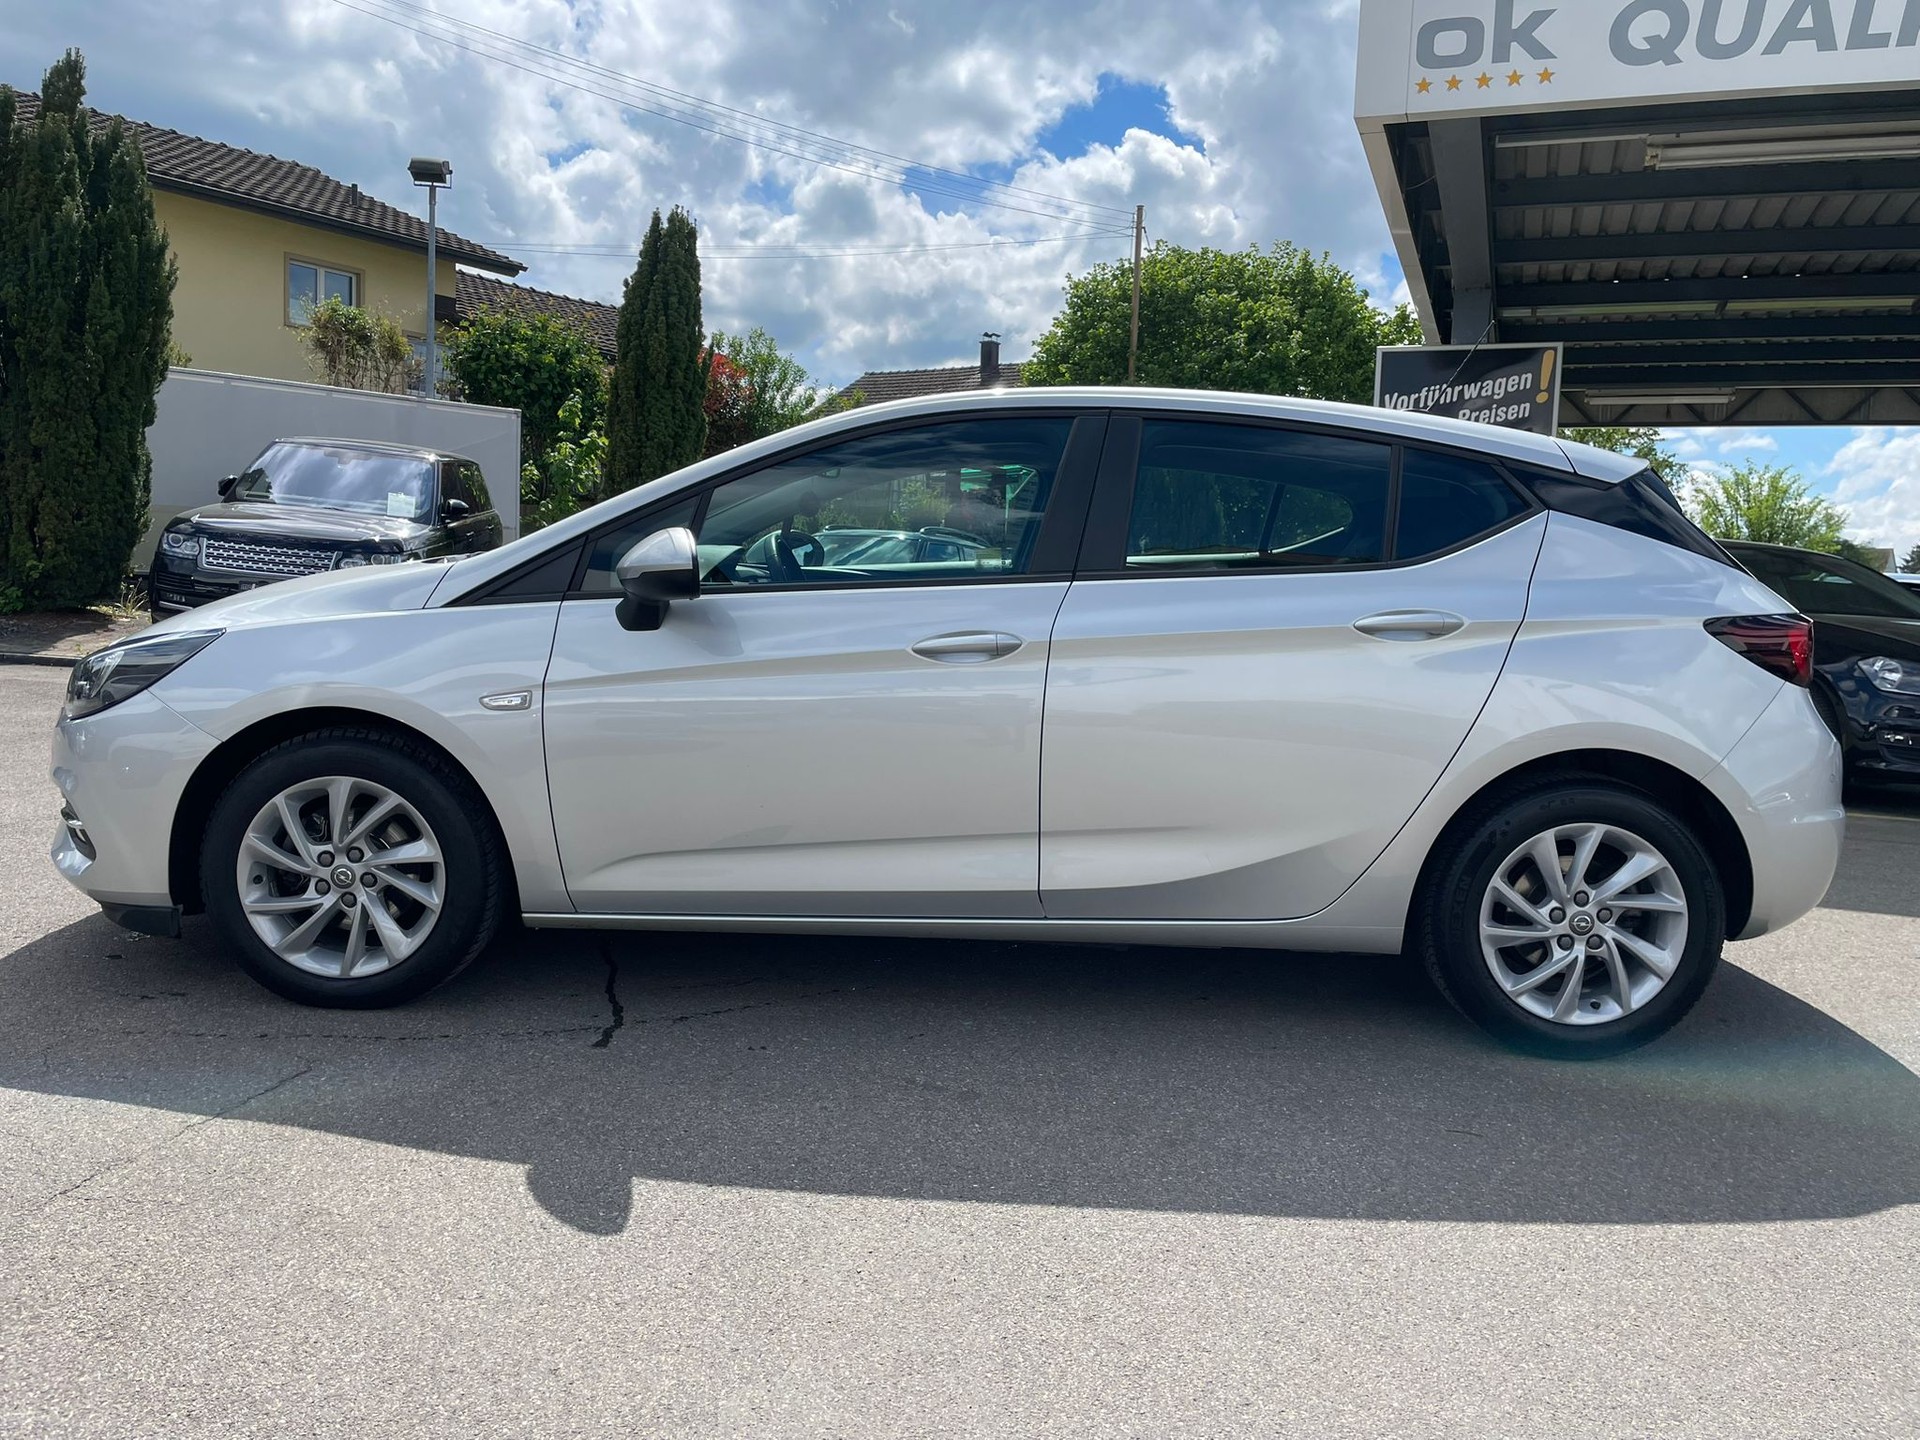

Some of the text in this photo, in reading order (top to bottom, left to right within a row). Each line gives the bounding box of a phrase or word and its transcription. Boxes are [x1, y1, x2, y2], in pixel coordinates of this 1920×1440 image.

[1416, 0, 1558, 70] ok
[1384, 371, 1533, 411] Vorführwagen
[1458, 401, 1531, 425] Preisen
